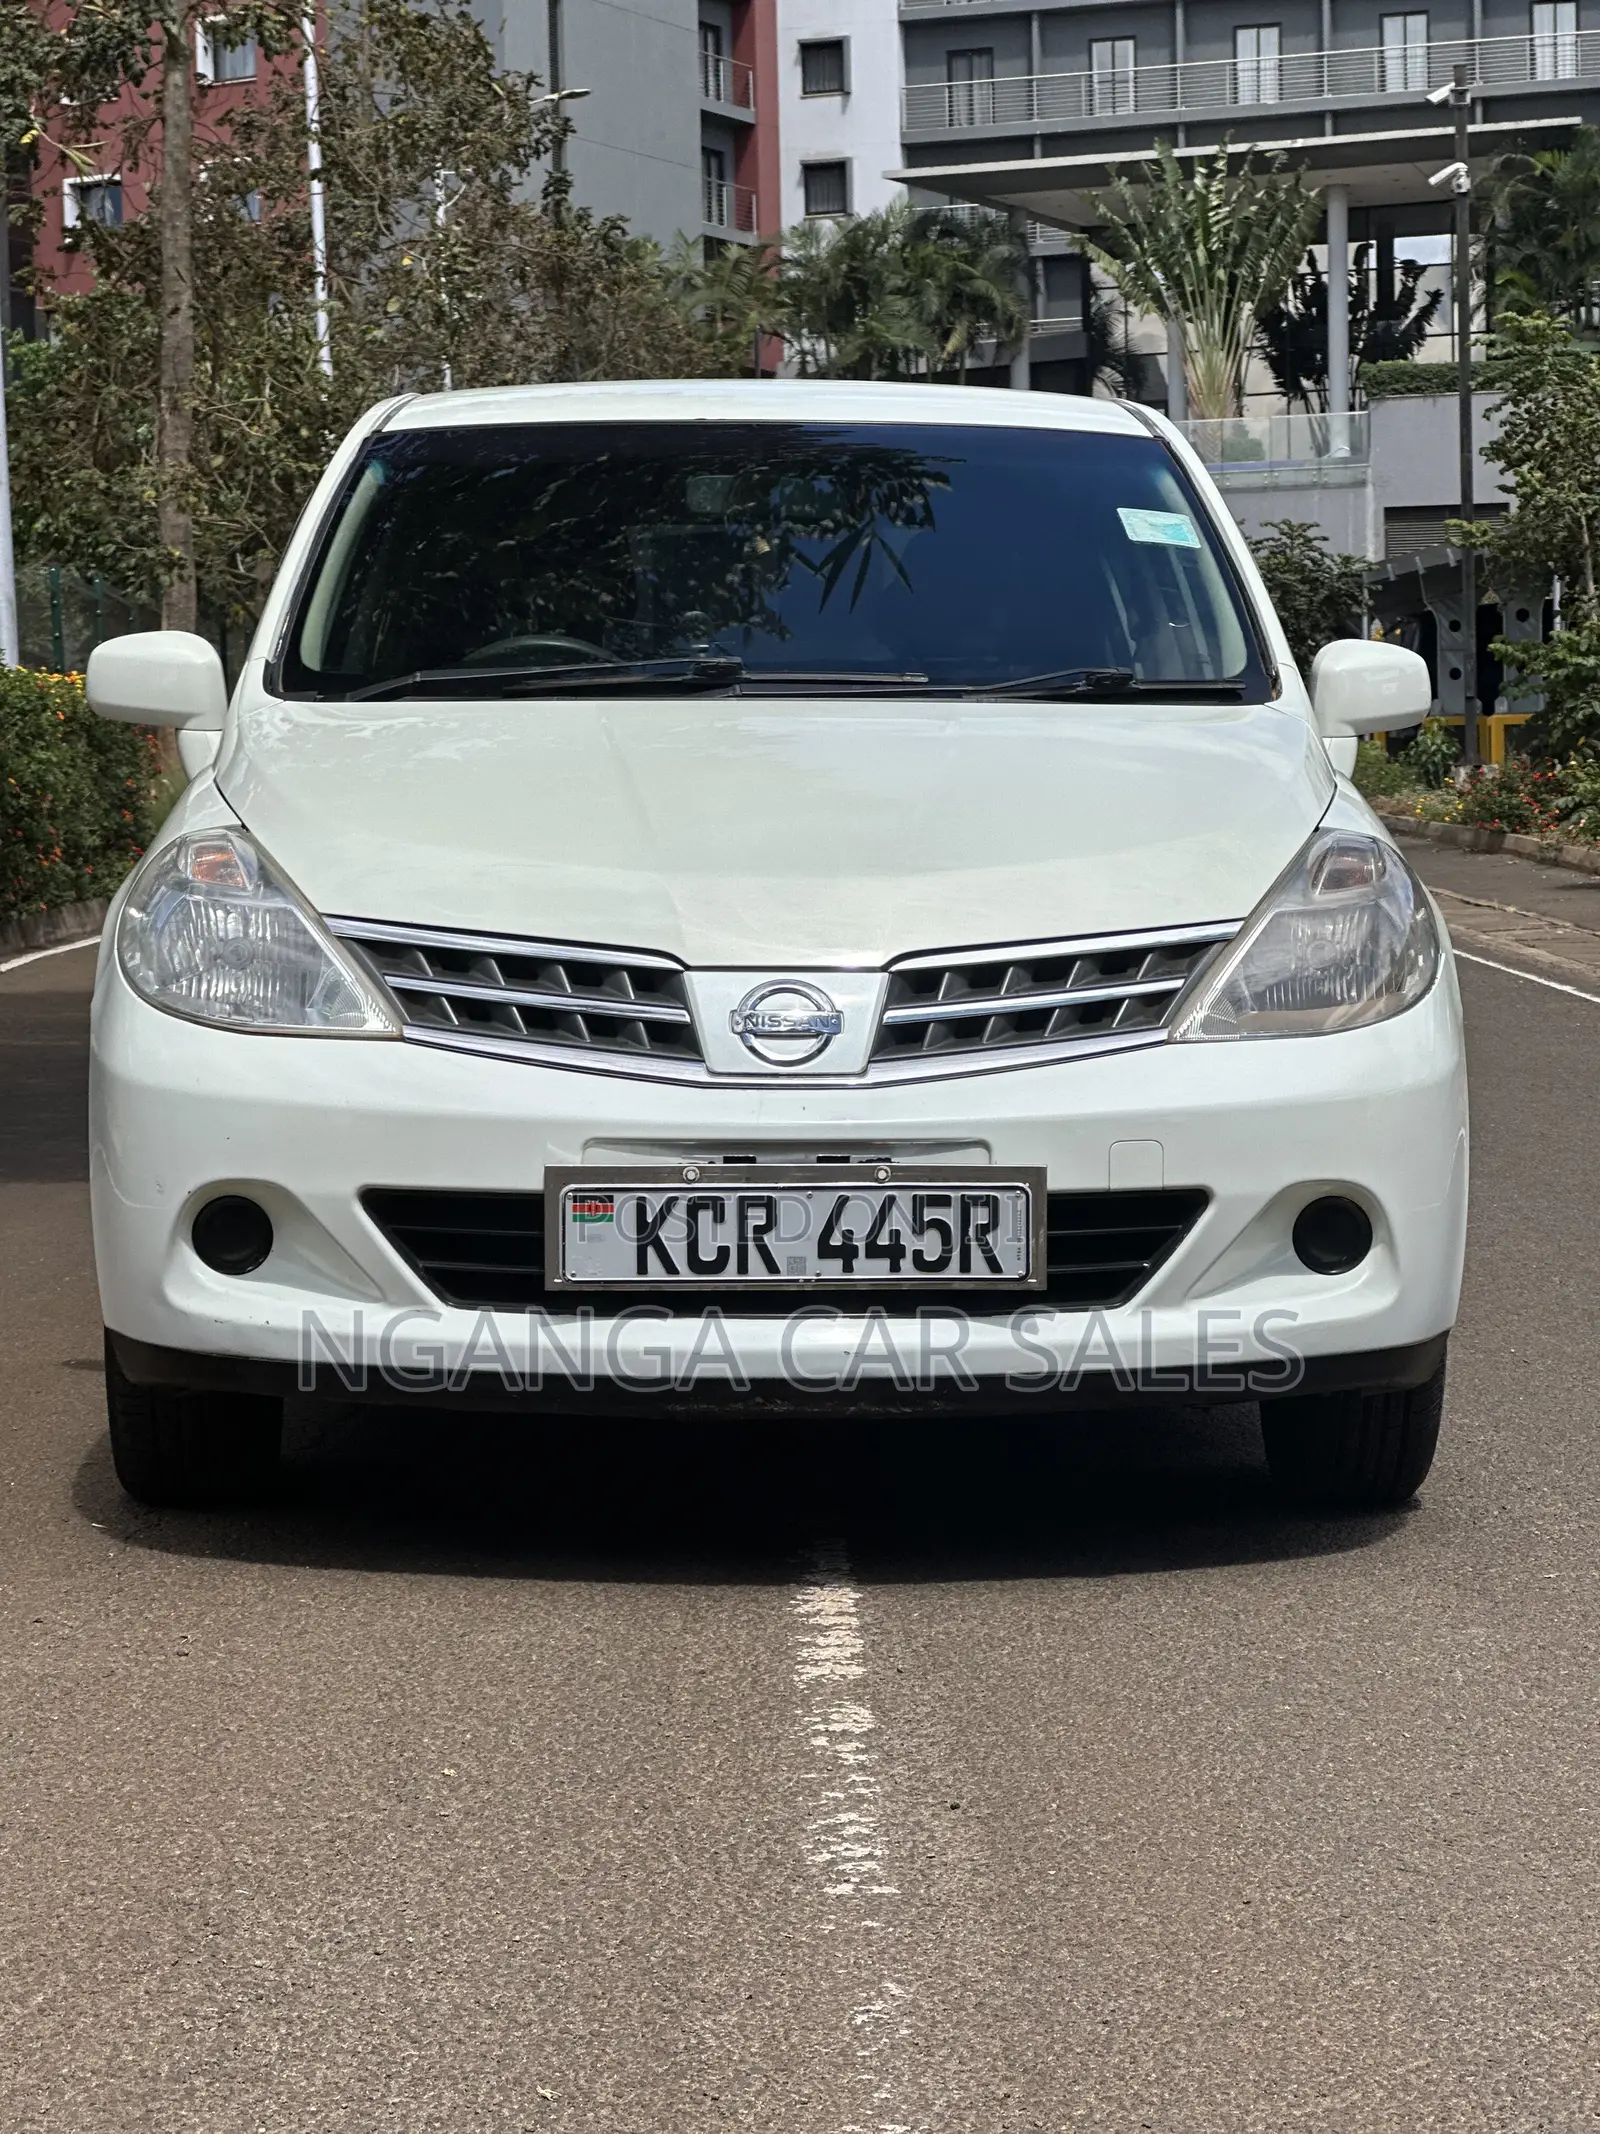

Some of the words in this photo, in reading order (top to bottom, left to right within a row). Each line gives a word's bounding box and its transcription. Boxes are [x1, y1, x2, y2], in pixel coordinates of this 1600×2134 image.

[743, 1014, 830, 1029] NISSAN
[636, 1194, 782, 1275] KCR
[816, 1194, 1004, 1274] 445R
